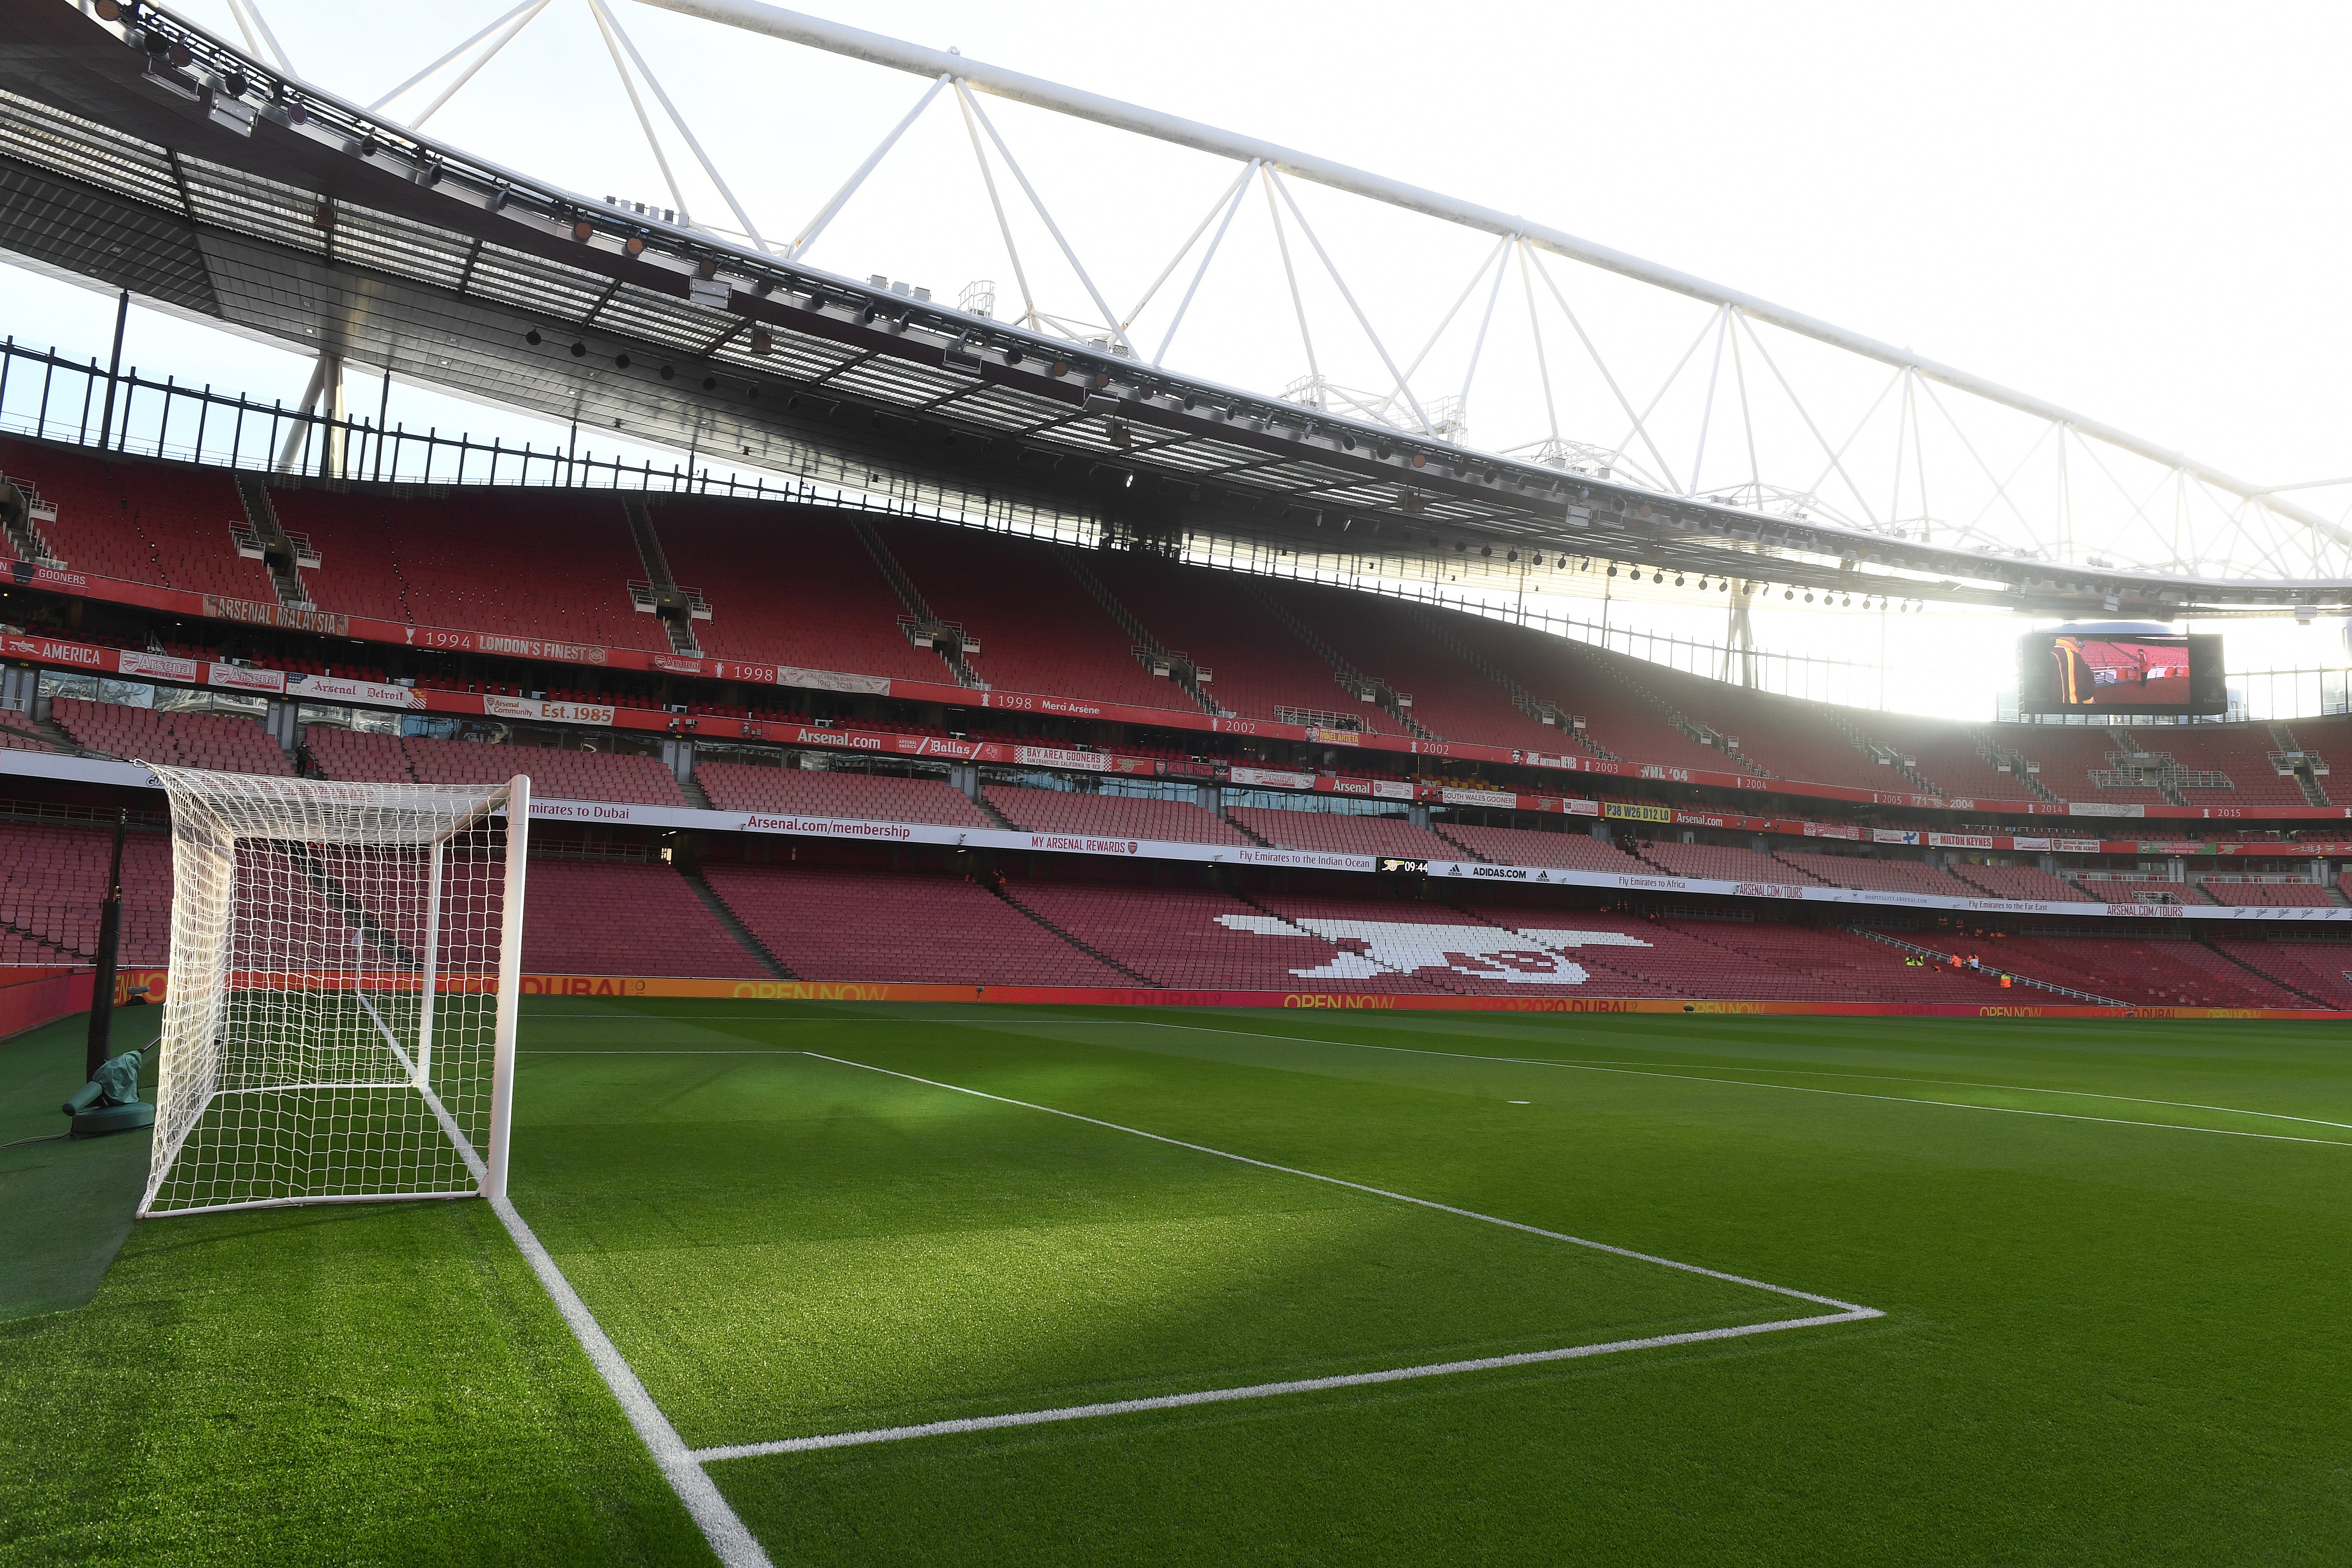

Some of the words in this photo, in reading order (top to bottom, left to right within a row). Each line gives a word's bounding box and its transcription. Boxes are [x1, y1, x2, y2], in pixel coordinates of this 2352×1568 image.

[39, 569, 86, 585] GOONERS
[218, 598, 272, 624] ARSENAL
[276, 607, 336, 633] MALAYSIA
[425, 632, 471, 649] 1994
[42, 642, 100, 665] AMERICA
[479, 635, 540, 656] LONDON'S
[544, 643, 587, 661] FINEST
[139, 654, 195, 675] Arsenal
[666, 656, 701, 669] Arsenal
[229, 668, 280, 685] Arsenal
[734, 666, 773, 681] 1998
[311, 681, 357, 695] Arsenal
[366, 687, 404, 700] Detroit
[495, 700, 519, 708] Arsenal
[999, 695, 1032, 709] 1998
[1042, 700, 1067, 711] Merci
[1068, 703, 1100, 714] Arsène
[494, 707, 533, 717] Community
[541, 704, 570, 719] Est.
[573, 707, 611, 722] 1985
[1225, 720, 1255, 734] 2002
[797, 728, 881, 749] Arsenal.com
[1320, 732, 1337, 740] MIKEL
[1337, 734, 1358, 743] ARTETA
[929, 738, 970, 755] Dallas
[1423, 743, 1449, 755] 2002
[1027, 748, 1042, 758] BAY
[1044, 750, 1063, 760] AREA
[1066, 753, 1101, 763] GOONERS
[1540, 758, 1560, 767] ANTONIO
[1595, 762, 1619, 774] 2003
[1263, 772, 1296, 783] Arsenal
[1746, 779, 1767, 790] 2004
[1333, 779, 1370, 794] Arsenal
[1486, 796, 1516, 804] GOONERS
[1573, 800, 1597, 811] Arsenal
[1883, 795, 1901, 805] 2005
[1949, 799, 1974, 809] 2004
[529, 803, 573, 816] mirates
[577, 807, 589, 817] to
[593, 806, 629, 819] Dubai
[1606, 804, 1622, 817] P38
[1624, 806, 1641, 818] W26
[1643, 808, 1658, 820] D12
[2041, 805, 2063, 813] 2014
[2218, 809, 2241, 817] 2015
[1676, 812, 1723, 827] Arsenal.com
[748, 815, 910, 840] Arsenal.com/membership
[1032, 836, 1044, 848] MY
[1046, 837, 1083, 850] ARSENAL
[1086, 840, 1125, 853] REWARDS
[1940, 836, 1965, 845] MILTON
[1966, 837, 1991, 847] KEYNES
[1240, 850, 1252, 862] Fly
[1255, 851, 1290, 863] Emirates
[1292, 855, 1301, 863] to
[1303, 855, 1315, 865] the
[1318, 855, 1343, 866] Indian
[1345, 858, 1369, 868] Ocean
[1405, 861, 1428, 873] 09:44
[1473, 867, 1527, 879] ADIDAS.COM
[1619, 876, 1629, 886] Fly
[1631, 877, 1657, 887] Emirates
[1658, 879, 1665, 887] to
[1666, 879, 1685, 888] Africa
[1740, 883, 1803, 898] ARSENAL.COM/TOURS
[1968, 900, 1978, 909] Fly
[1979, 901, 2005, 909] Emirates
[2025, 903, 2034, 911] Far
[2107, 905, 2183, 917] ARSENAL.COM/TOURS
[734, 983, 814, 999] OPEN
[820, 984, 889, 1001] NOW
[1284, 994, 1342, 1008] OPEN
[1346, 995, 1395, 1010] NOW
